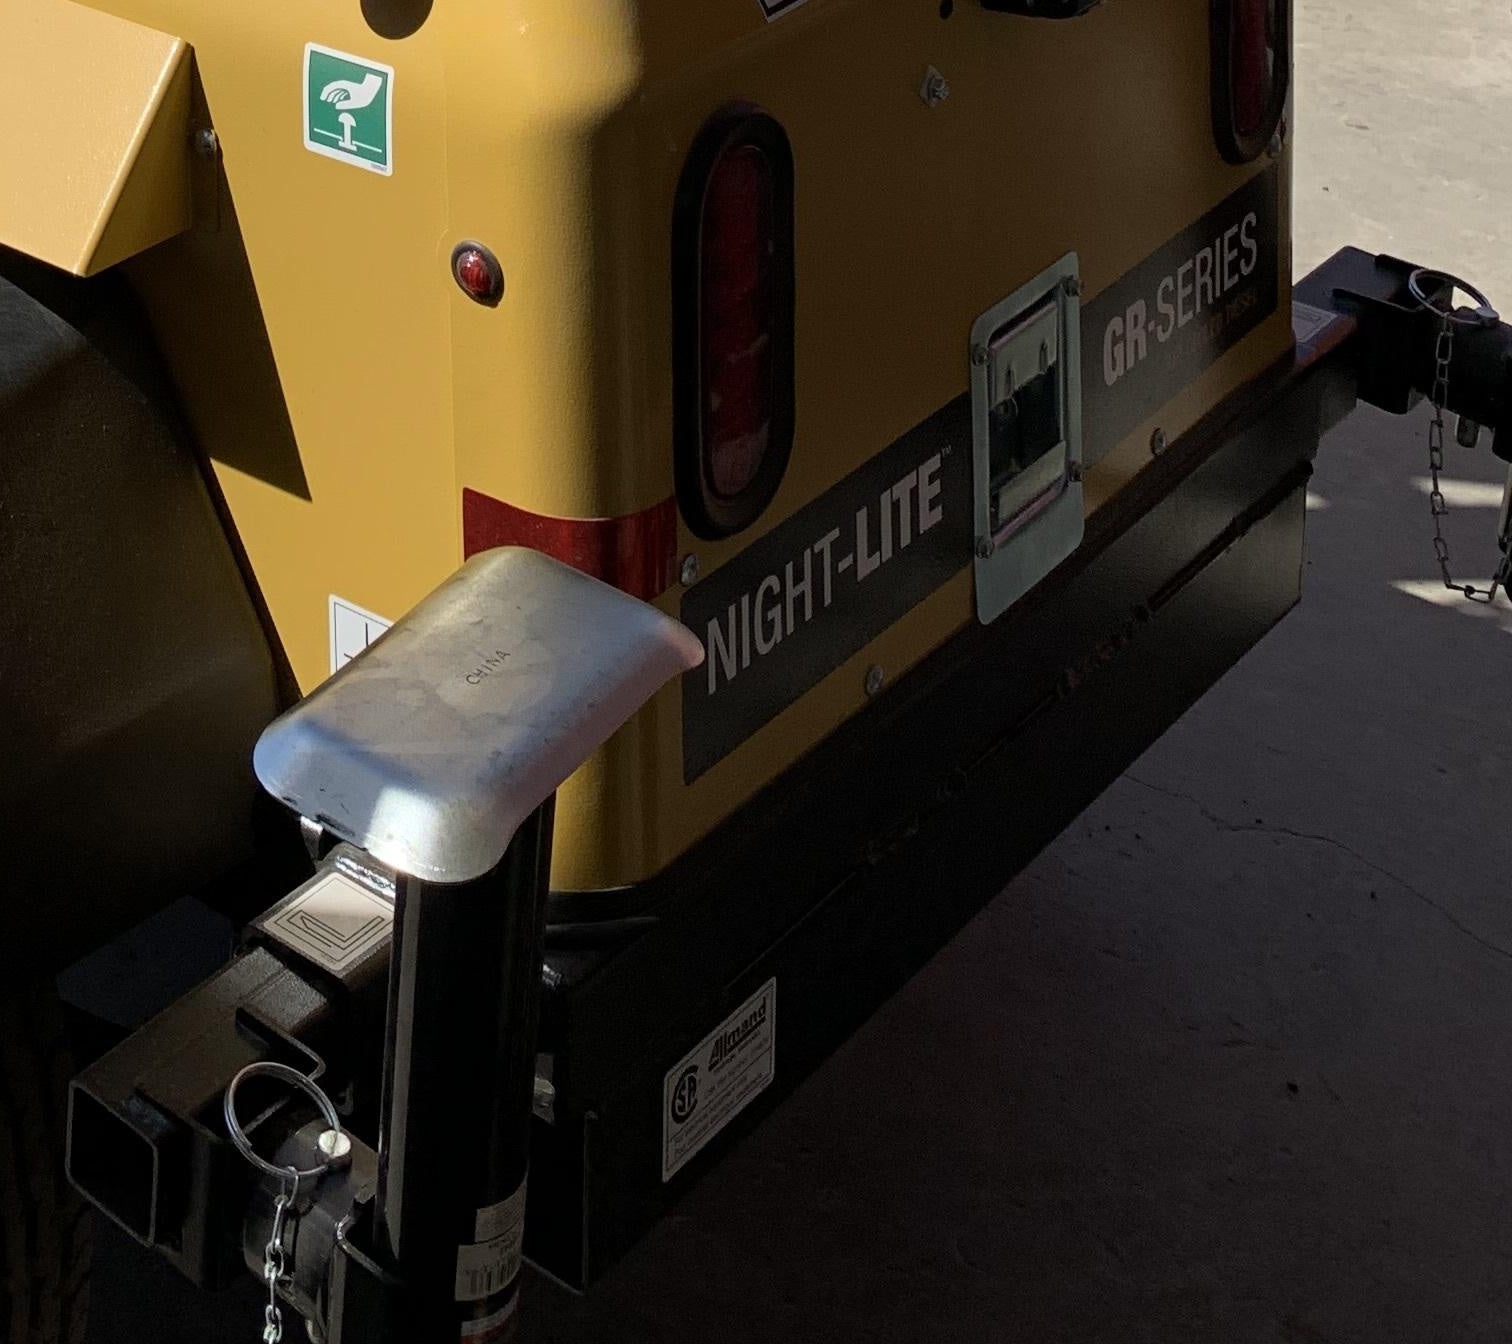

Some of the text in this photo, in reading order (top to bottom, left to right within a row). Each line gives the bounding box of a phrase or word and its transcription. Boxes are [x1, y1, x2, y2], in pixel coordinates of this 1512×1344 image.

[1102, 210, 1258, 387] GR-SERIES
[704, 450, 945, 696] NIGHT-LITE
[465, 650, 511, 685] CHINA
[708, 996, 767, 1064] Allmand
